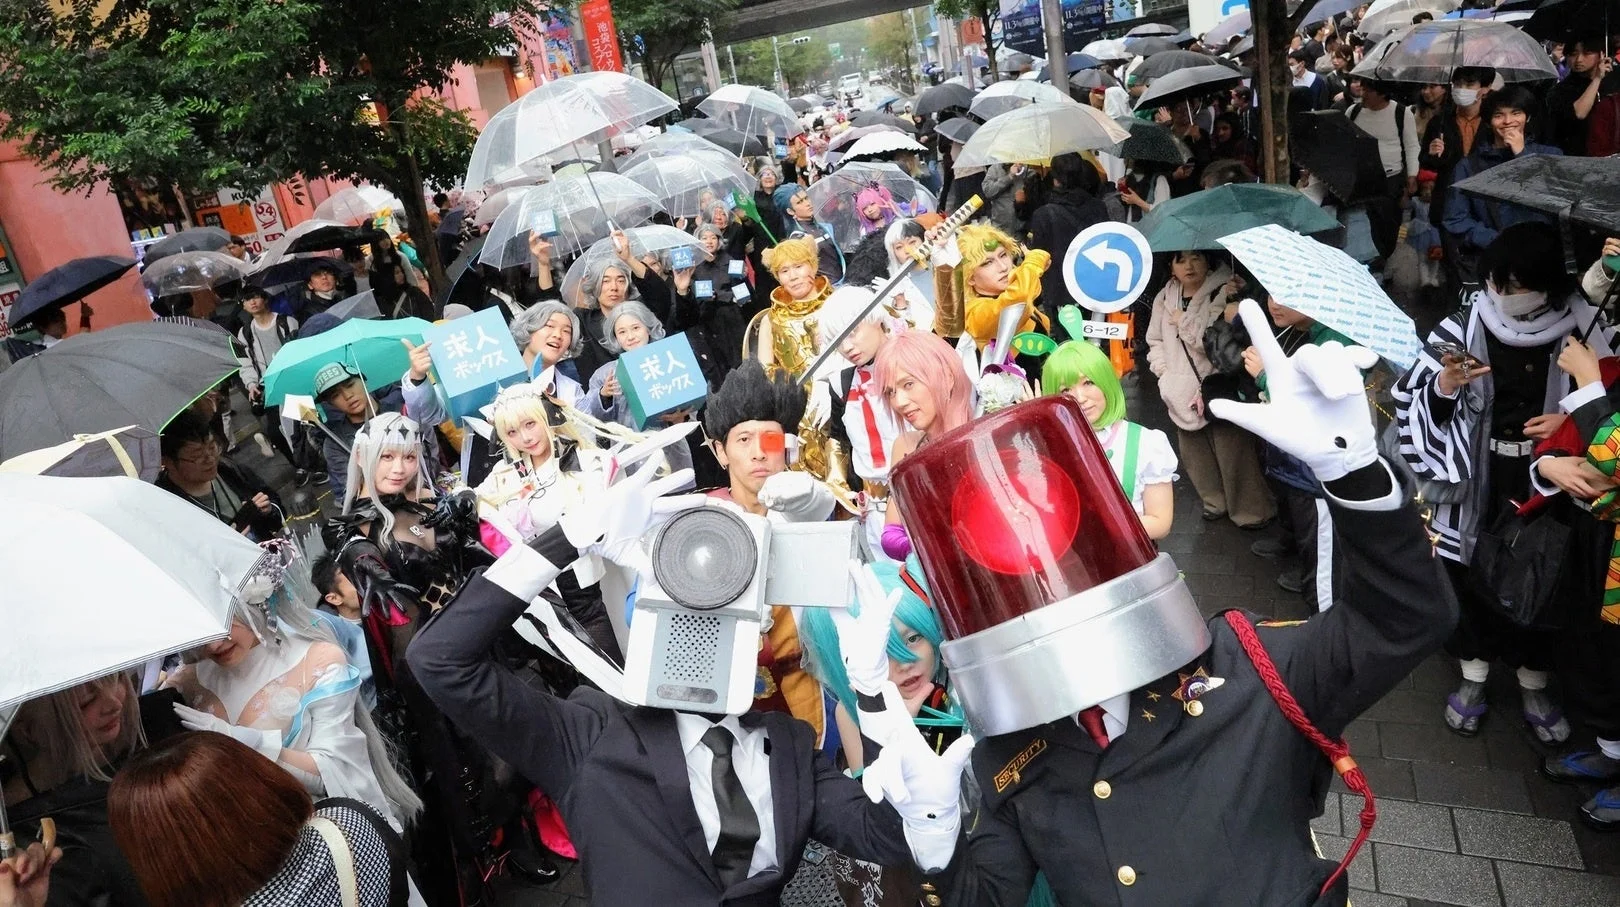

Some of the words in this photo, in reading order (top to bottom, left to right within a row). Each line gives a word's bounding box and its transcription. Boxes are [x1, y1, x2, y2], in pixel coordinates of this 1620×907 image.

[443, 325, 499, 359] 求人
[453, 349, 508, 379] ボックス
[640, 350, 686, 381] 求人
[648, 373, 694, 400] ボックス
[999, 739, 1041, 787] SECURITY
